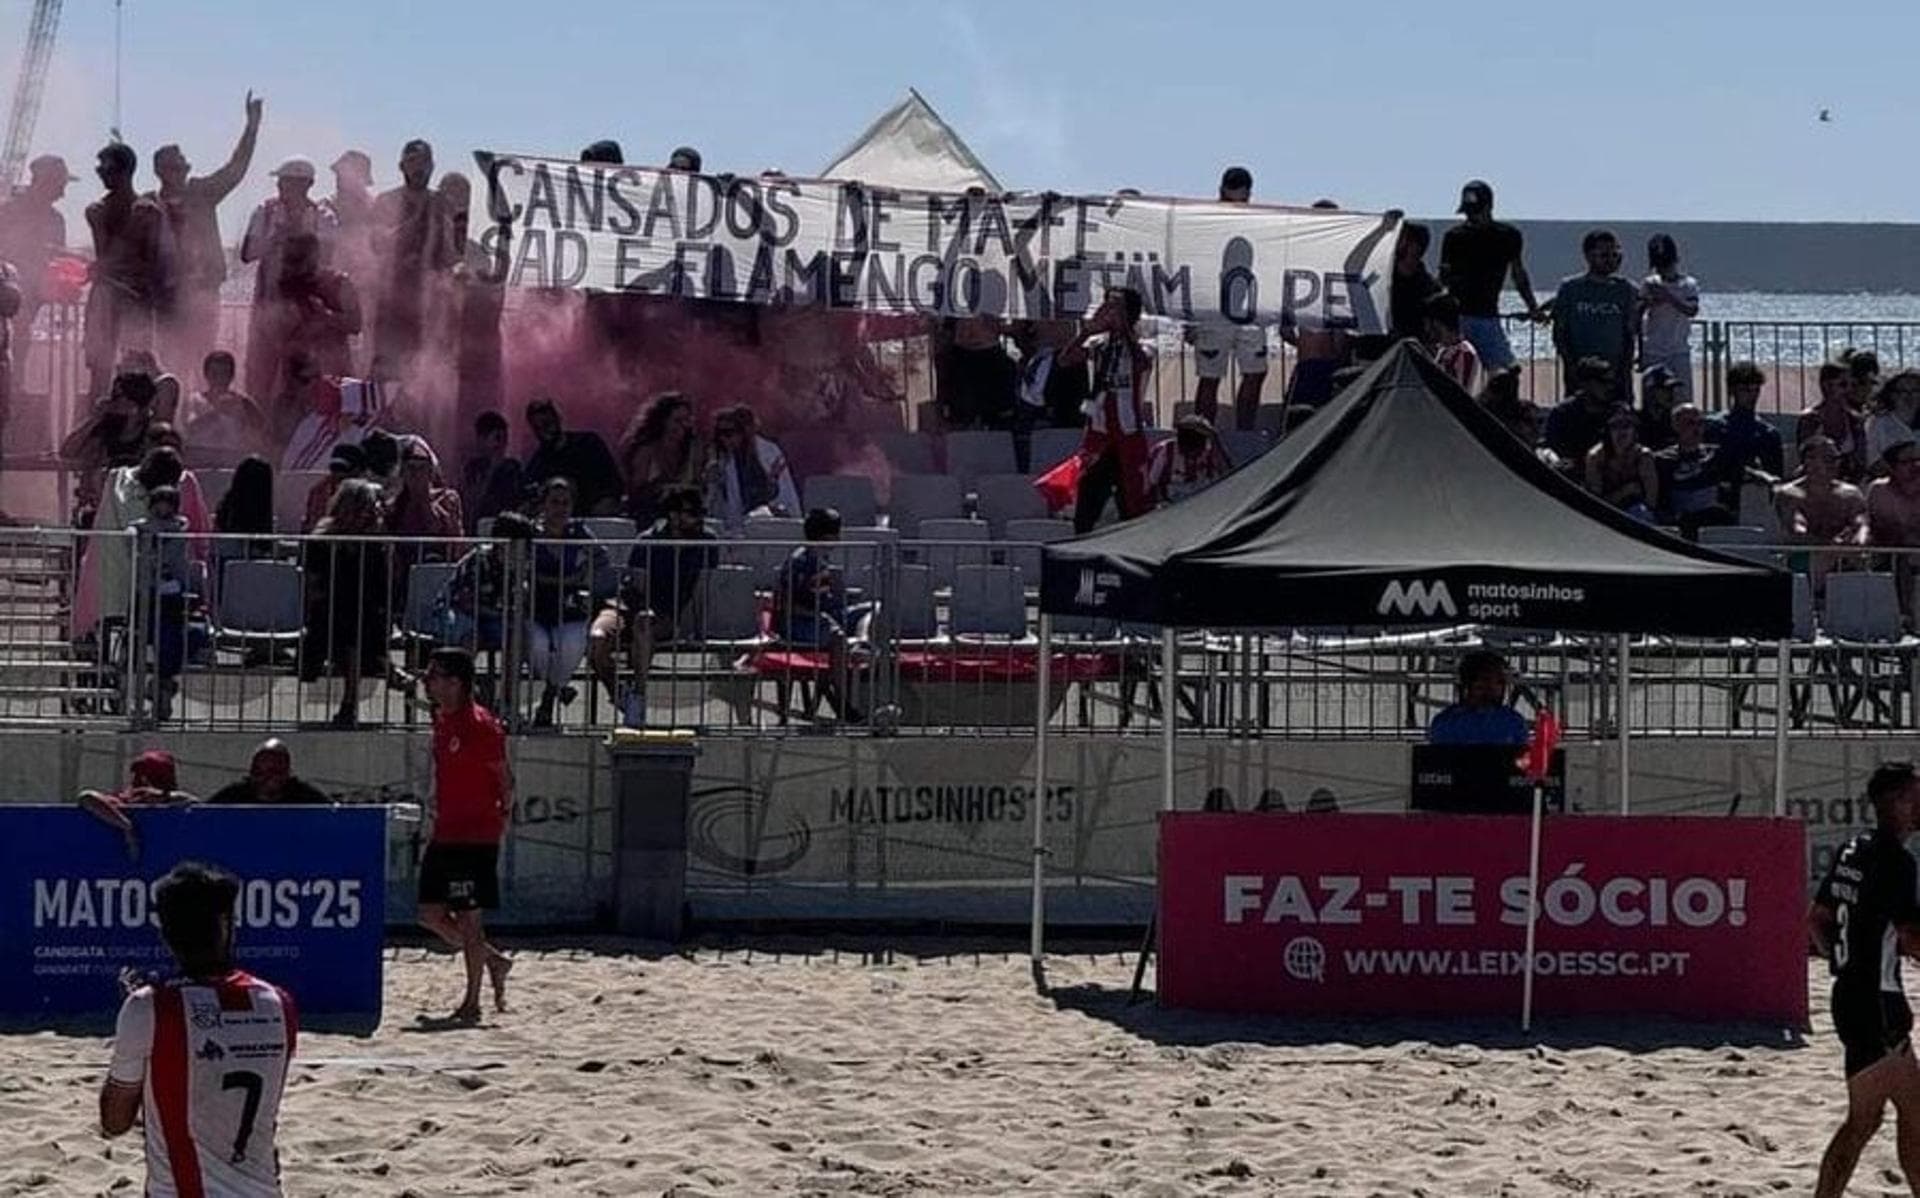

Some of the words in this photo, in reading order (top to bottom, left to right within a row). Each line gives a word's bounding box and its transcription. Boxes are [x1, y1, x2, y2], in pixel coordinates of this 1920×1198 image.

[487, 160, 800, 248] CANSADOS
[835, 186, 902, 252] DE
[477, 226, 589, 289] SAD
[671, 241, 983, 316] FLAMENGO
[1220, 265, 1258, 325] O
[1467, 582, 1584, 602] matosinhos
[1468, 602, 1520, 620] sport
[1223, 875, 1476, 925] FAZ-TE
[1499, 862, 1748, 927] SÓCIO!
[1344, 951, 1691, 976] WWW.LEIXOESSC.PT
[222, 1070, 263, 1163] 7
